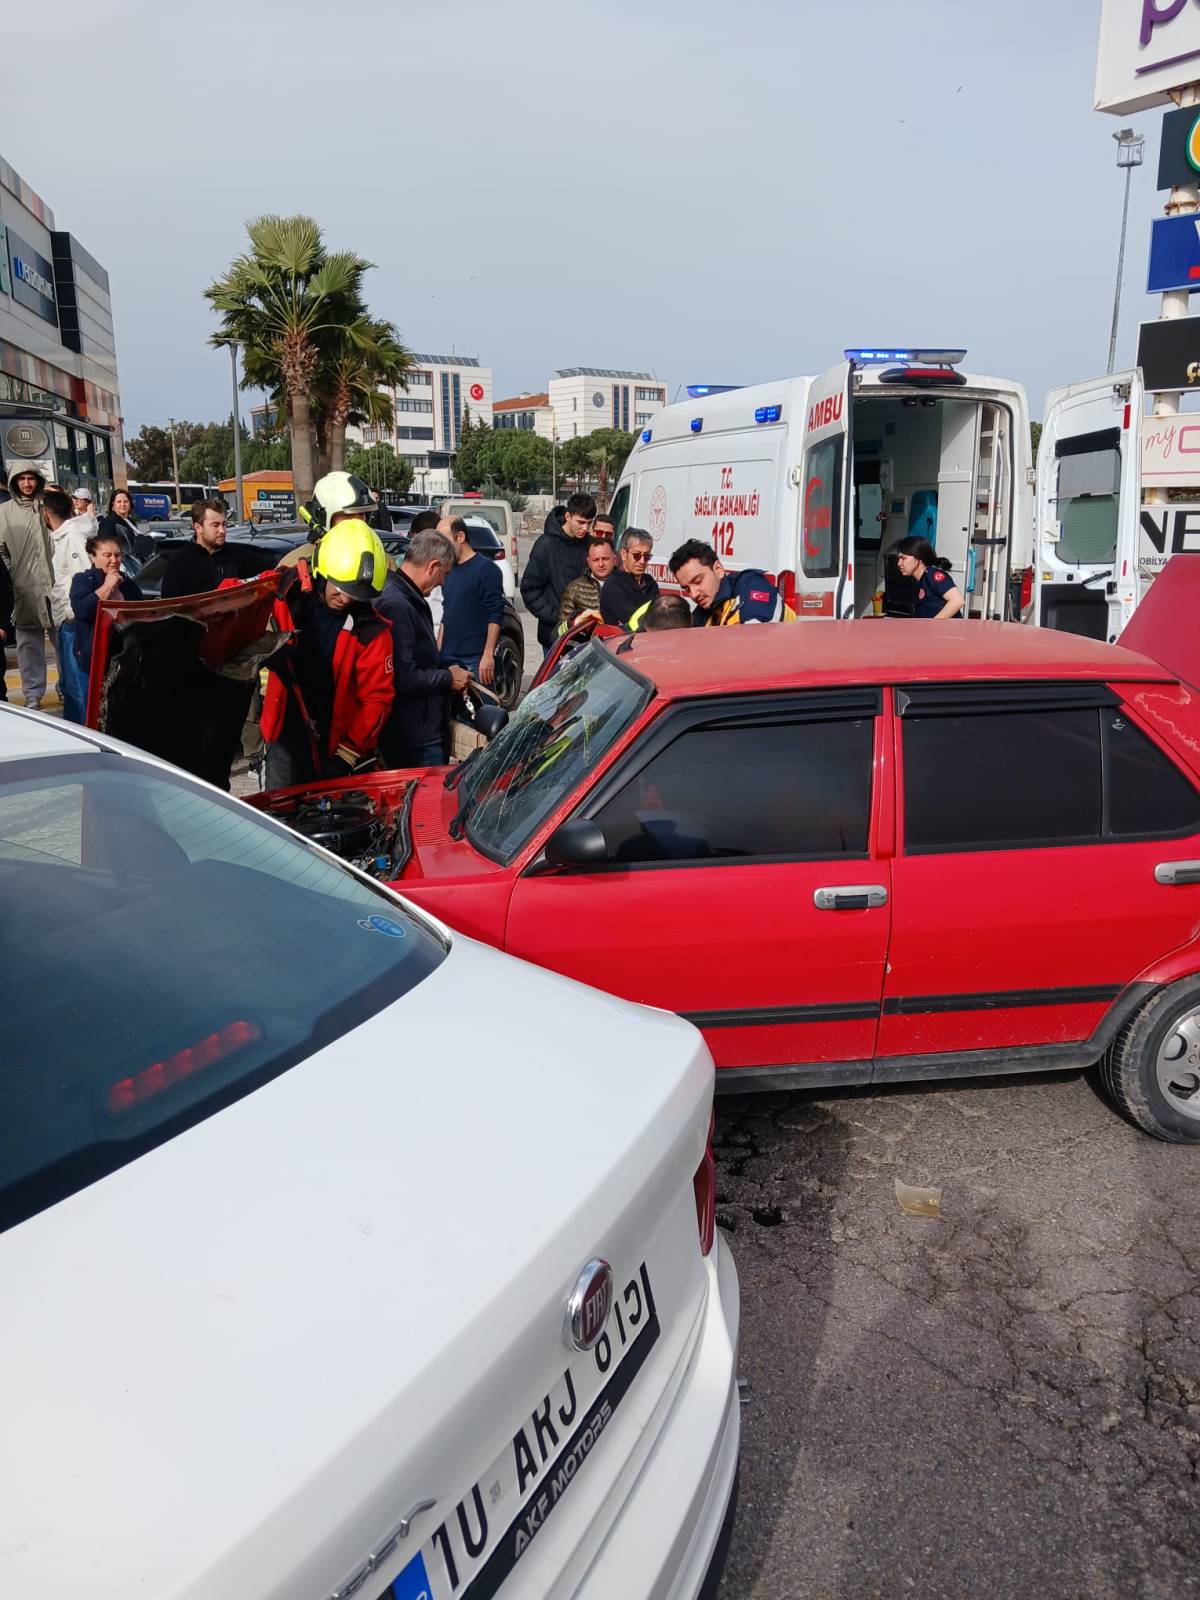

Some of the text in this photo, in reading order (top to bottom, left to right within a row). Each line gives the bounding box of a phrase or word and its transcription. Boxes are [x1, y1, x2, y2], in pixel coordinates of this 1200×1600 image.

[807, 391, 844, 433] AMBU
[1145, 424, 1176, 459] my
[721, 467, 733, 489] T.C.
[694, 490, 719, 516] SAĞLIK
[719, 488, 761, 516] BAKANLIĞI
[712, 521, 735, 556] 112
[1140, 555, 1168, 566] OBİLYA
[584, 1278, 610, 1336] FIAT
[550, 1400, 612, 1501] MOTORS
